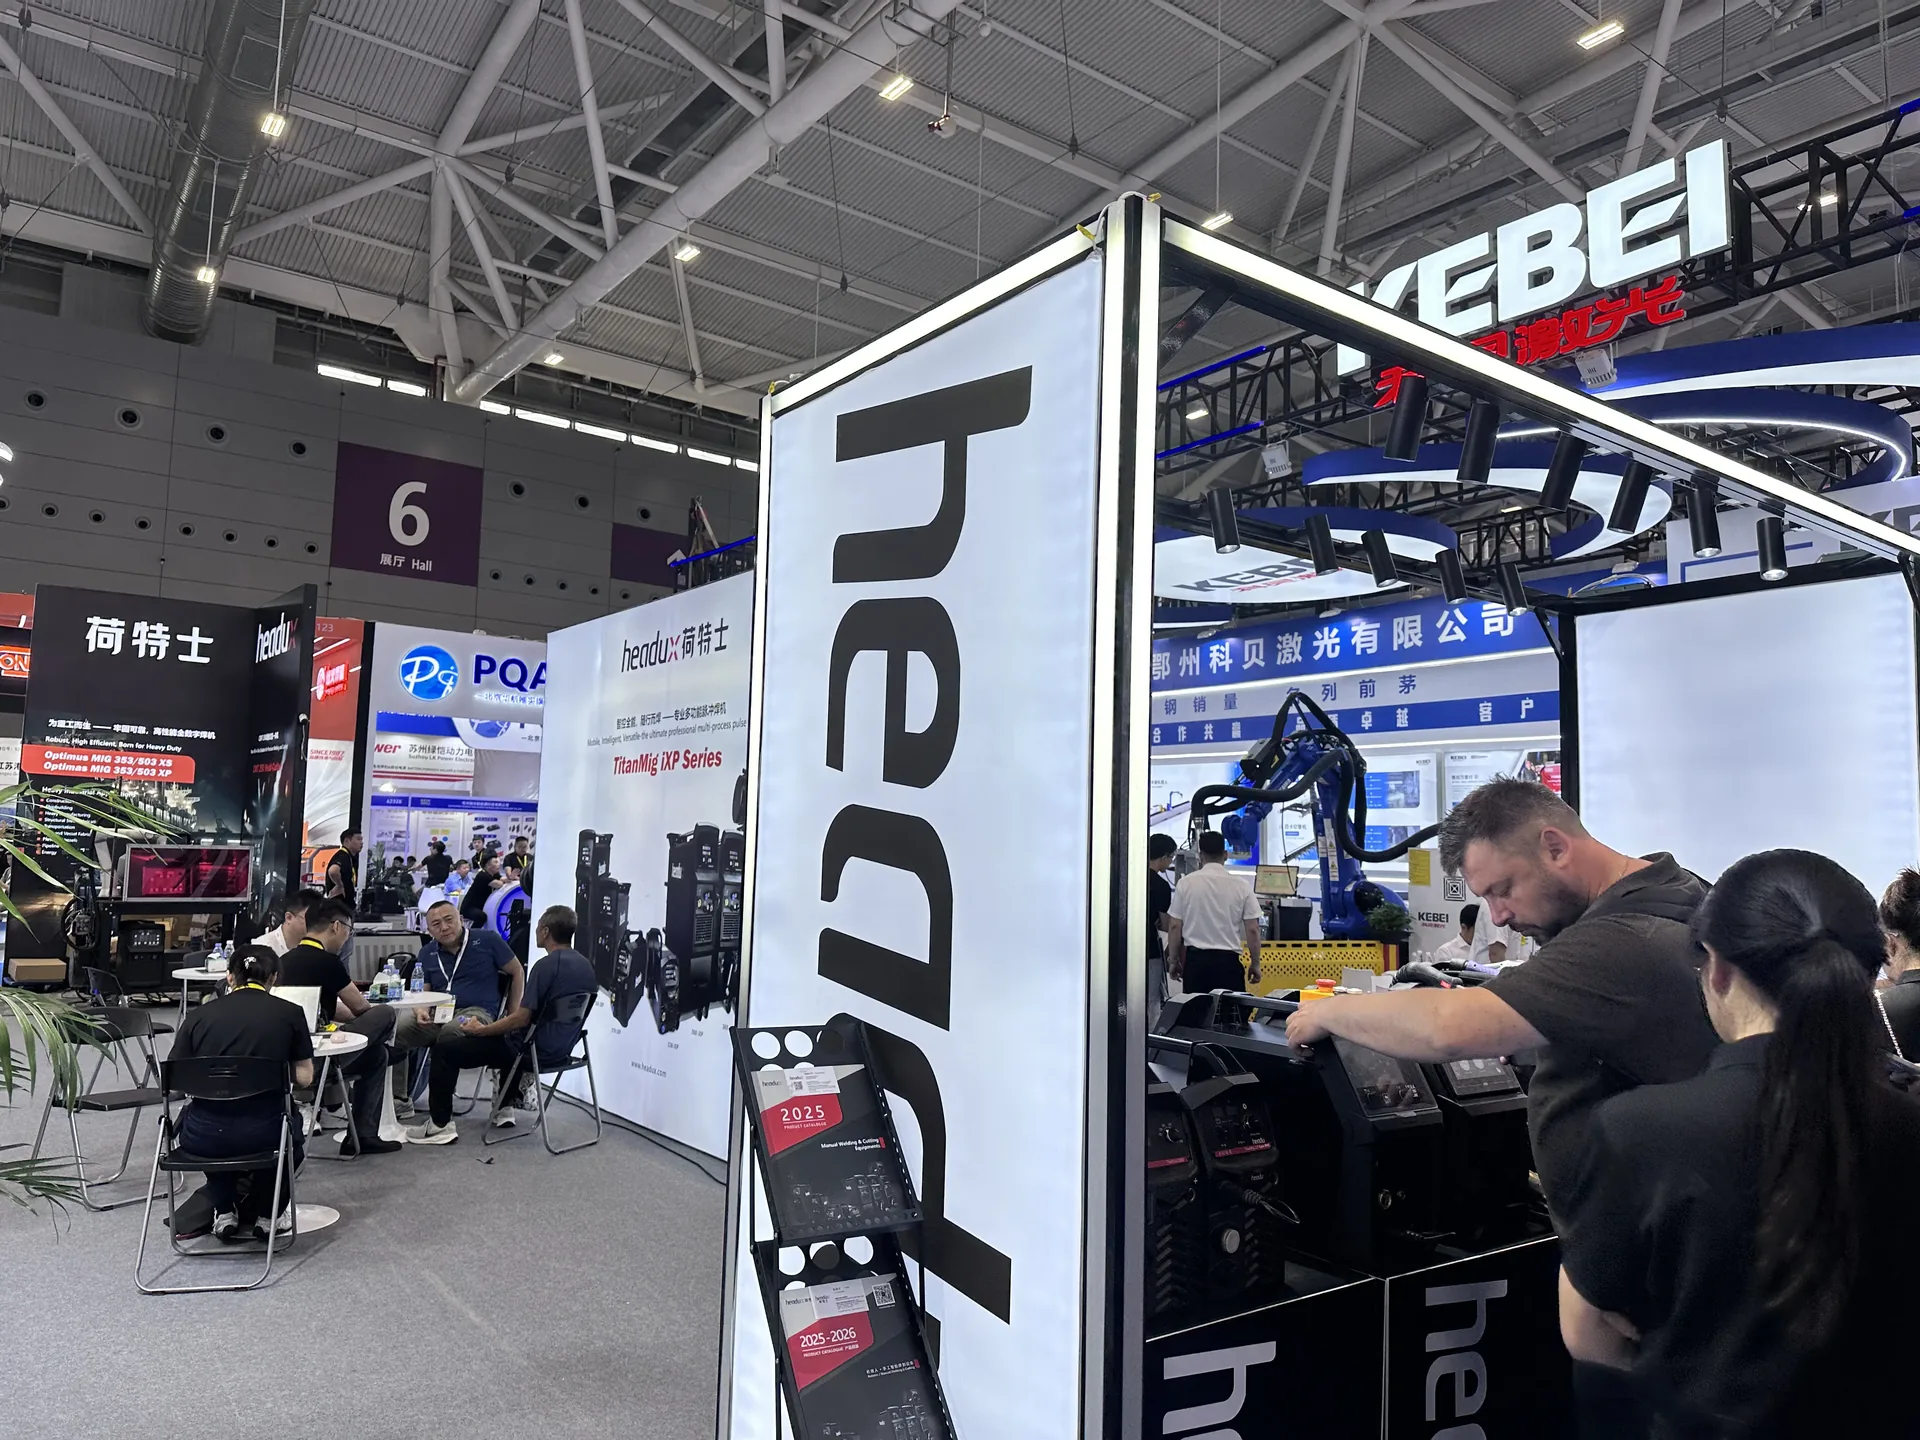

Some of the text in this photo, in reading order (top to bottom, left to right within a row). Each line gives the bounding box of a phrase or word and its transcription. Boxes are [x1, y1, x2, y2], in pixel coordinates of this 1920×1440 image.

[388, 481, 430, 547] 6
[380, 553, 433, 572] 展厅 Hall
[85, 615, 214, 664] 荷特士
[621, 618, 729, 673] headux 荷特士
[1152, 603, 1515, 681] 鄂州科贝激光有限公司
[649, 728, 667, 739] ultimate
[668, 724, 697, 737] professional
[697, 720, 732, 734] multi-process
[732, 717, 747, 731] pulse
[1152, 722, 1242, 744] 合作共赢
[1479, 697, 1534, 723] 客户
[45, 735, 70, 745] Robust,
[72, 738, 88, 747] High
[89, 739, 117, 748] Efficient,
[118, 741, 134, 749] Born
[146, 744, 166, 752] Heavy
[167, 745, 182, 753] Duty
[44, 751, 173, 767] Optimus MIG 353/503 XS
[613, 746, 723, 777] TitanMig iXP Series
[90, 764, 111, 774] MIG
[113, 766, 156, 777] 353/503
[158, 769, 172, 777] XP
[1417, 912, 1449, 923] KEBEI
[780, 1105, 825, 1122] 2025
[800, 1327, 857, 1348] 2025-2026
[803, 1350, 821, 1358] PRODUCT
